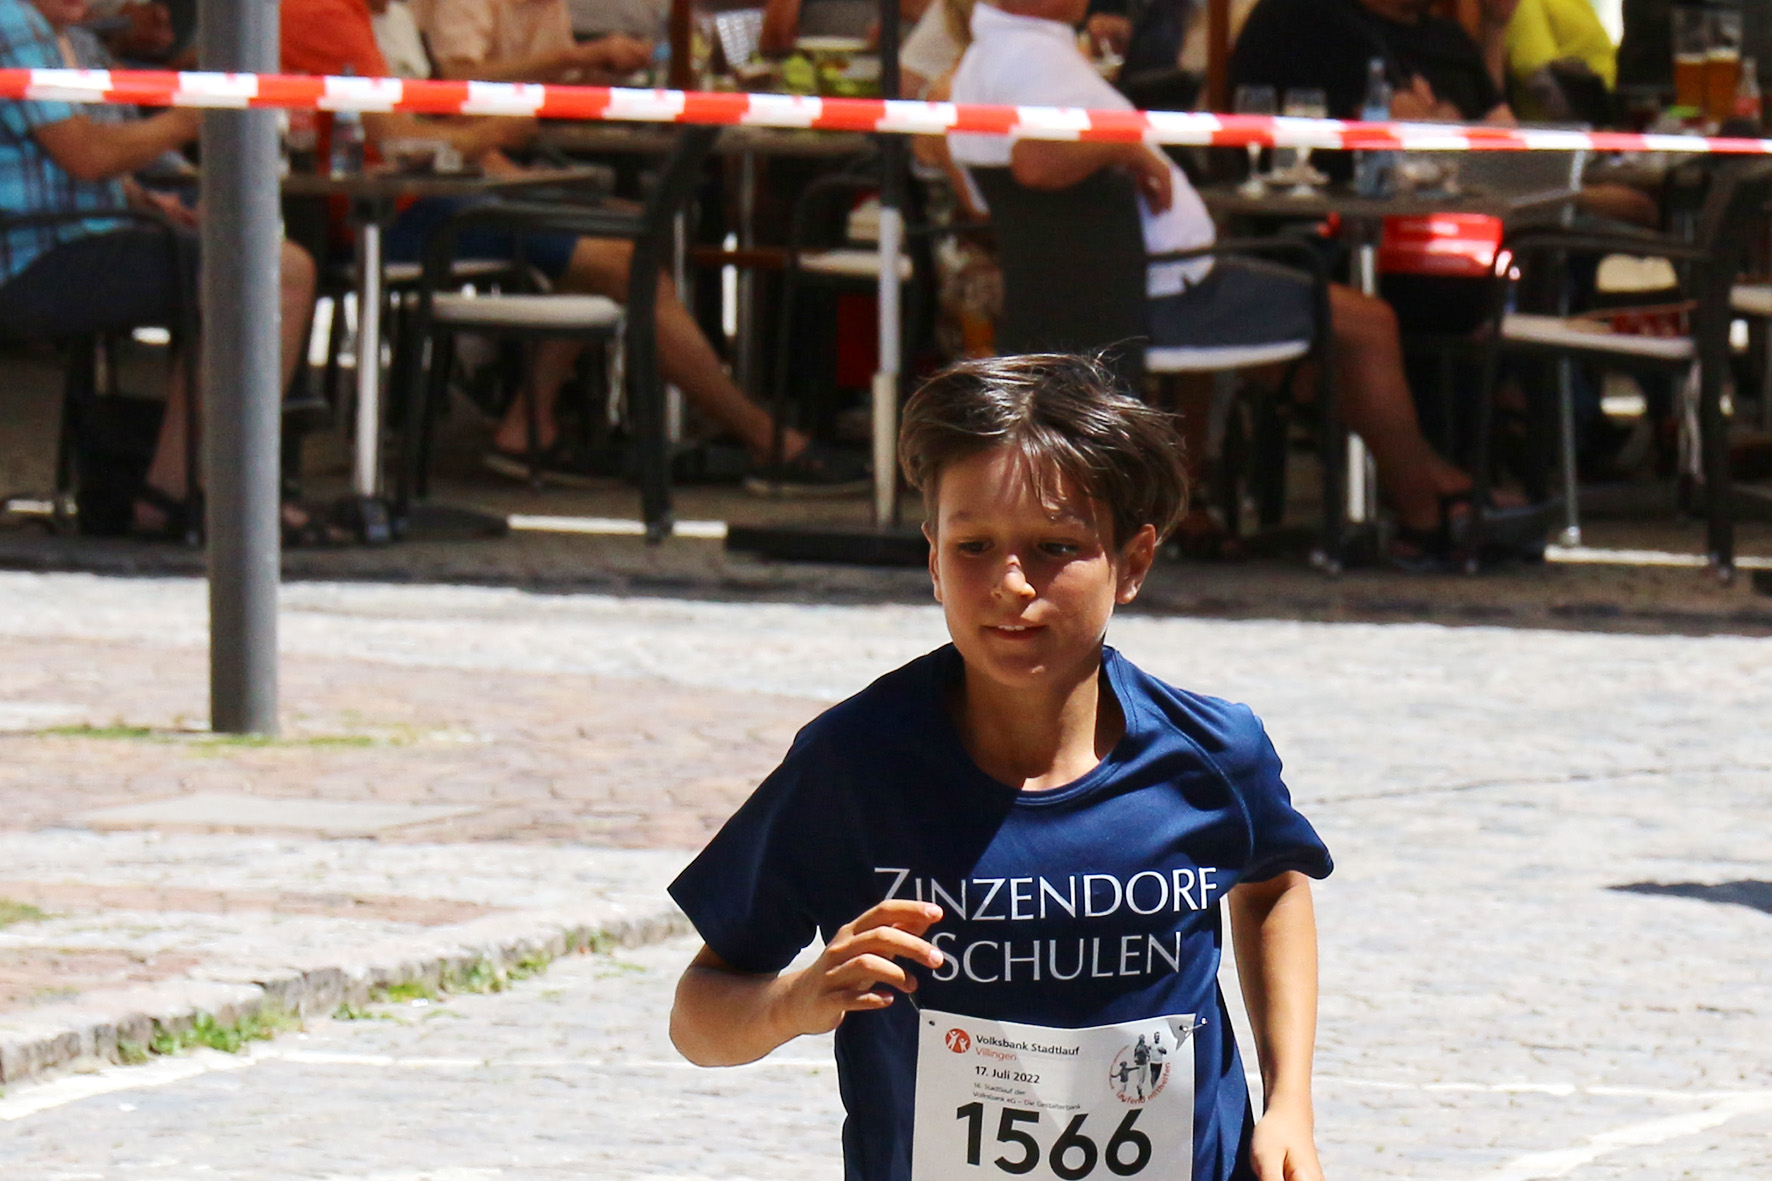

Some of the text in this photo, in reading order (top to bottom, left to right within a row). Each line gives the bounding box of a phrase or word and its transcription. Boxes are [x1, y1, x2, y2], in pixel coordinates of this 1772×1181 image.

[874, 866, 1219, 922] ZINZENDORF
[931, 931, 1182, 983] SCHULEN
[975, 1034, 1080, 1056] Volksbank Stadtlauf
[975, 1047, 1017, 1061] Villingen
[975, 1066, 1040, 1084] 17. Juli 2022
[973, 1091, 1005, 1102] Volksbank
[956, 1102, 1152, 1181] 1566
